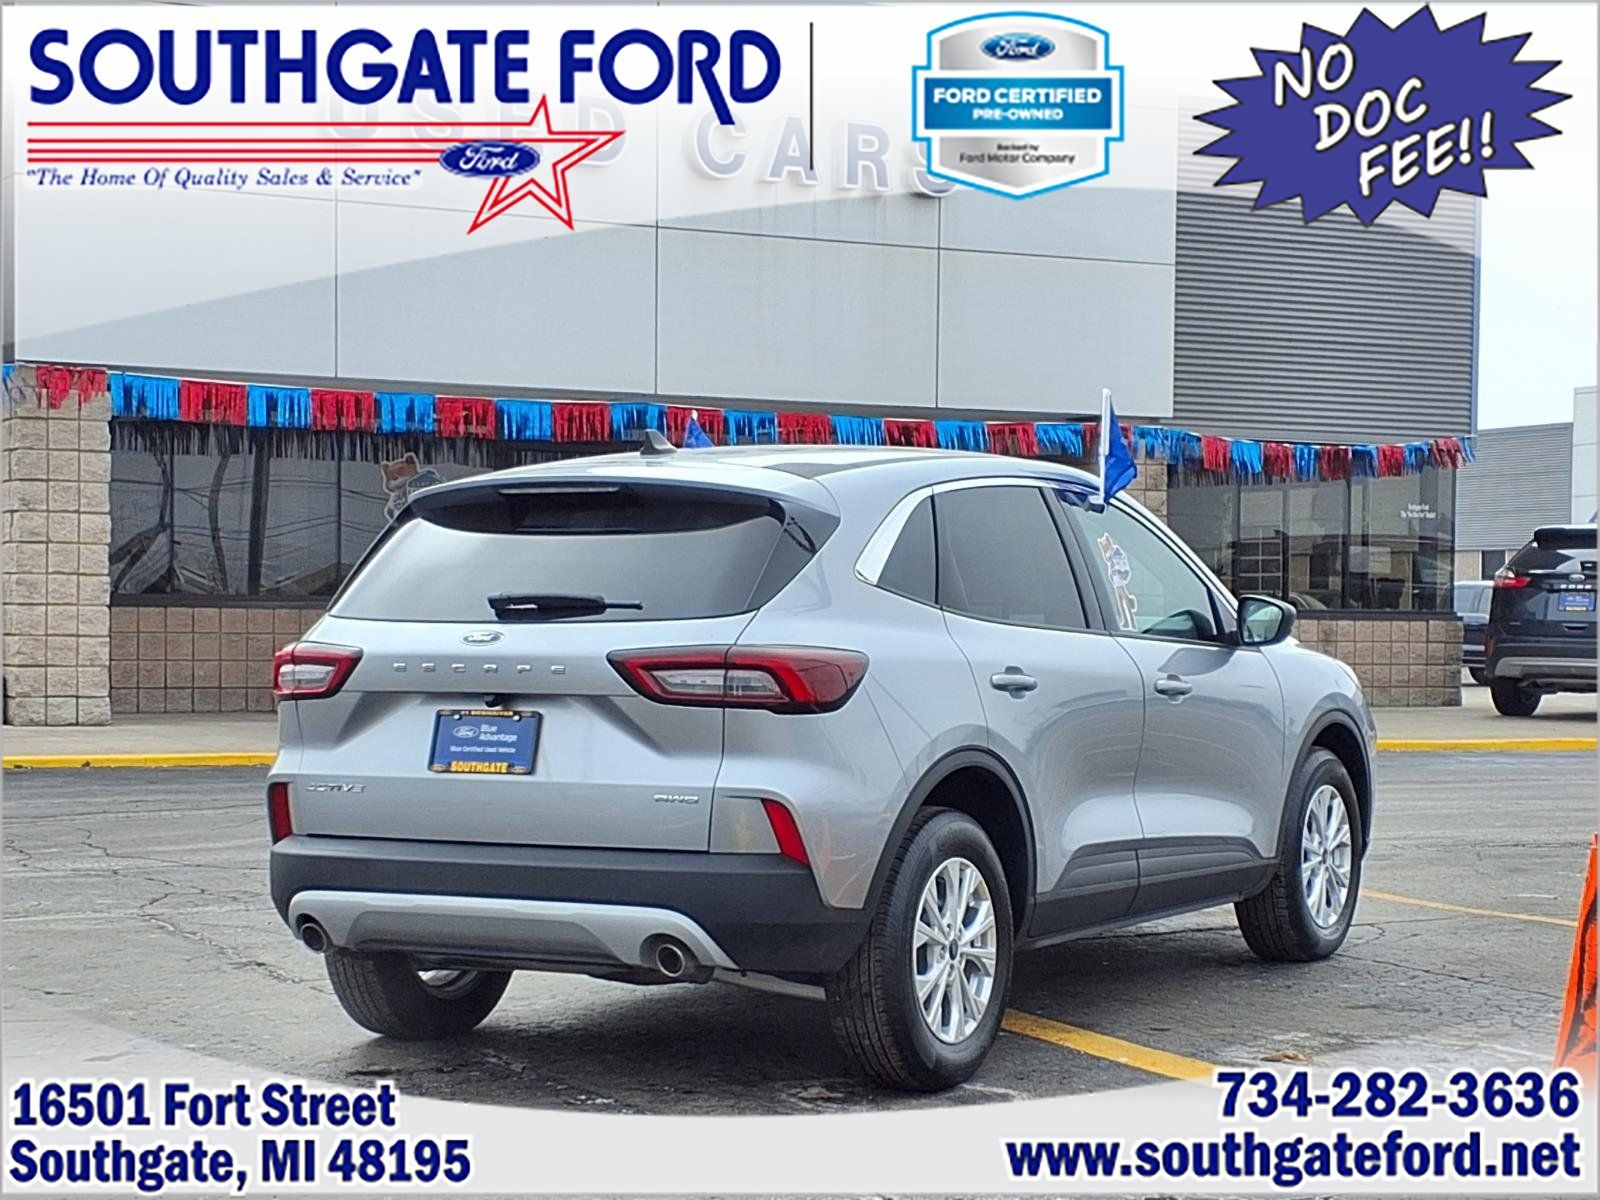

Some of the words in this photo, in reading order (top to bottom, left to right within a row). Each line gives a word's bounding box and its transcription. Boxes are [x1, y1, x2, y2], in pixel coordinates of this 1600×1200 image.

[393, 662, 567, 675] ESCAPE
[480, 724, 498, 733] Blue
[479, 733, 518, 743] Advantage
[450, 761, 509, 773] SOUTHGATE
